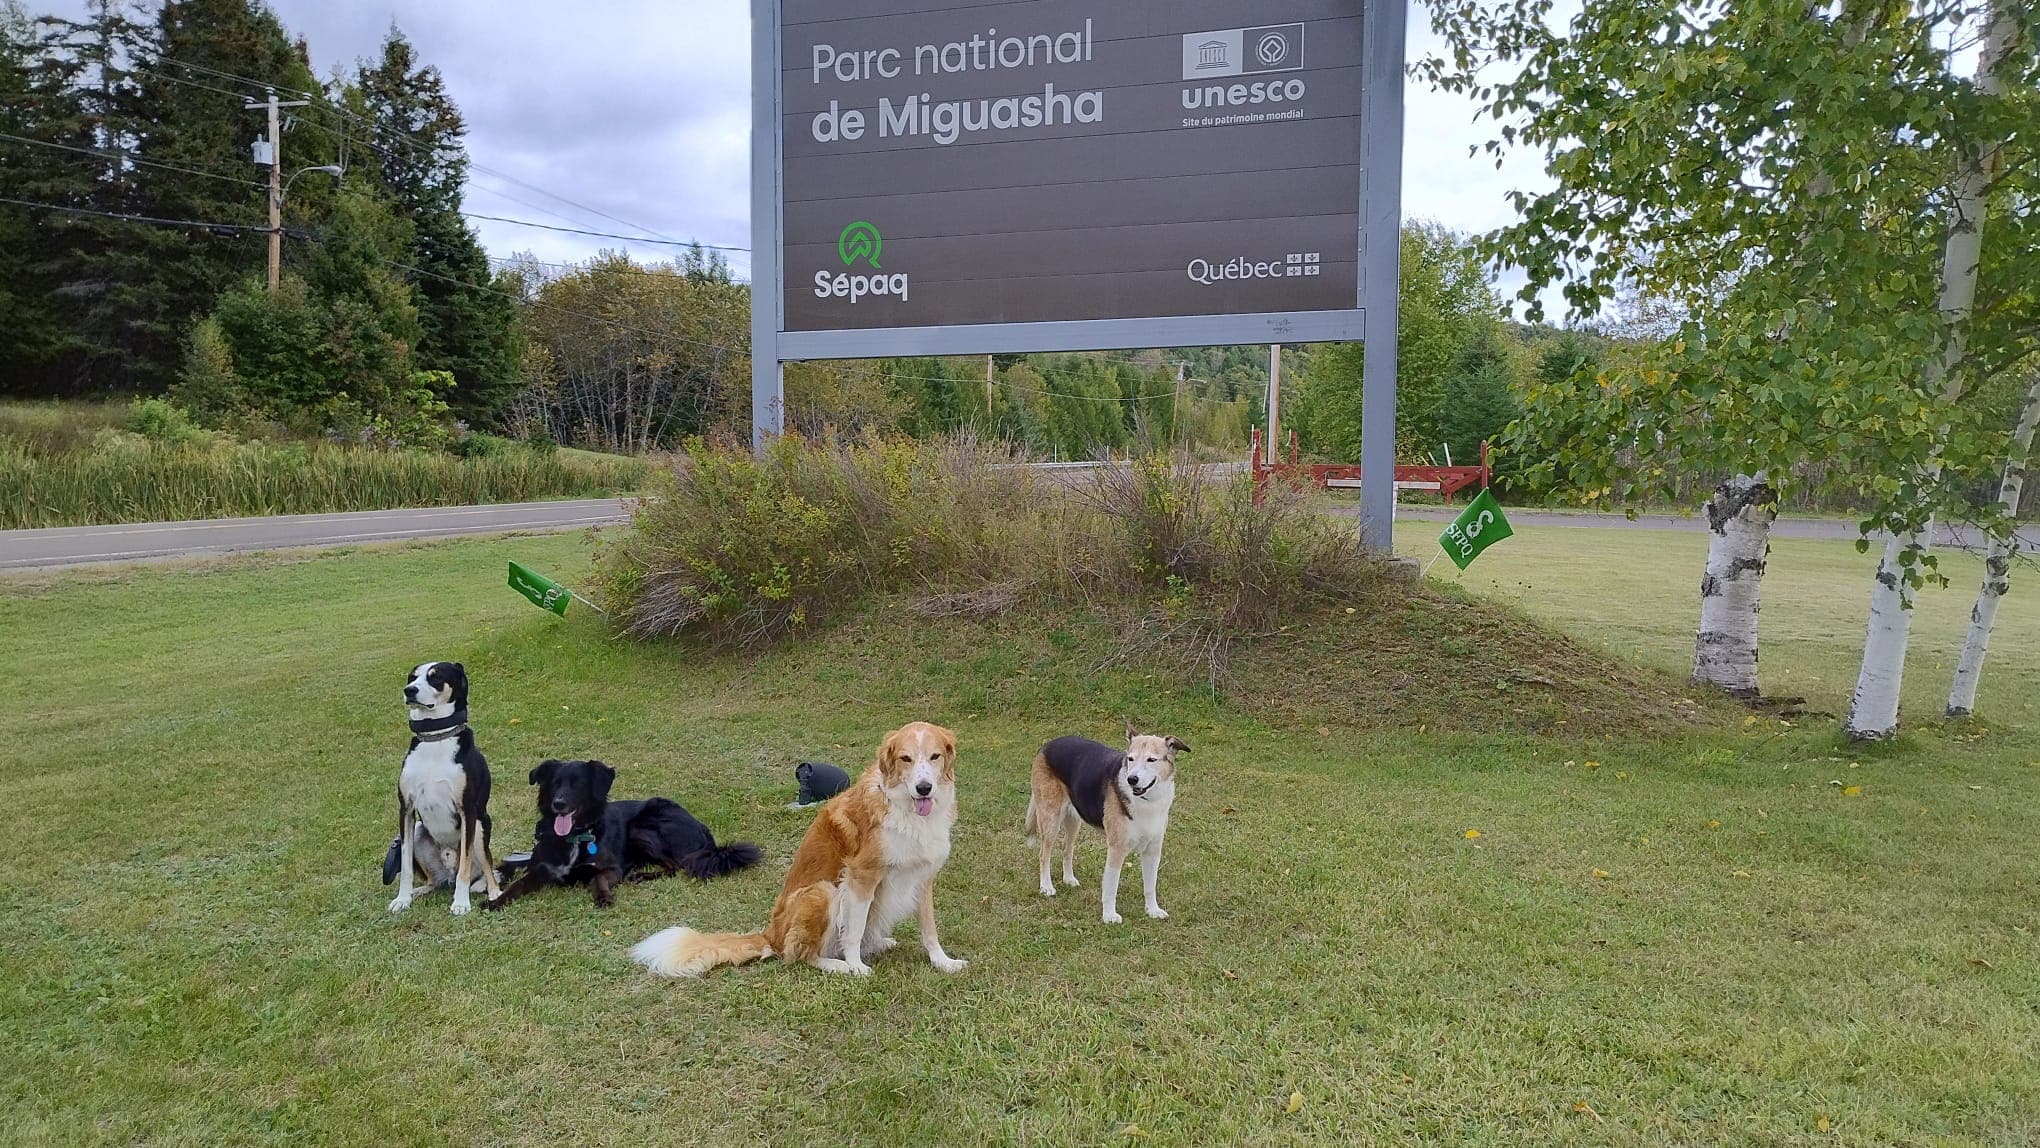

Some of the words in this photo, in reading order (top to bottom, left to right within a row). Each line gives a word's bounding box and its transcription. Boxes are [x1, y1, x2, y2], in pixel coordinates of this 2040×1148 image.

[812, 44, 901, 84] Parc
[915, 18, 1092, 75] national
[1182, 79, 1306, 109] unesco
[811, 100, 865, 143] de
[879, 82, 1103, 145] Miguasha
[1182, 118, 1200, 127] Site
[1201, 116, 1213, 126] du
[1215, 111, 1265, 126] patrimoine
[1266, 109, 1304, 120] mondial
[814, 270, 908, 304] Sépaq
[1187, 256, 1283, 285] Québec
[1446, 523, 1473, 559] SFPQ
